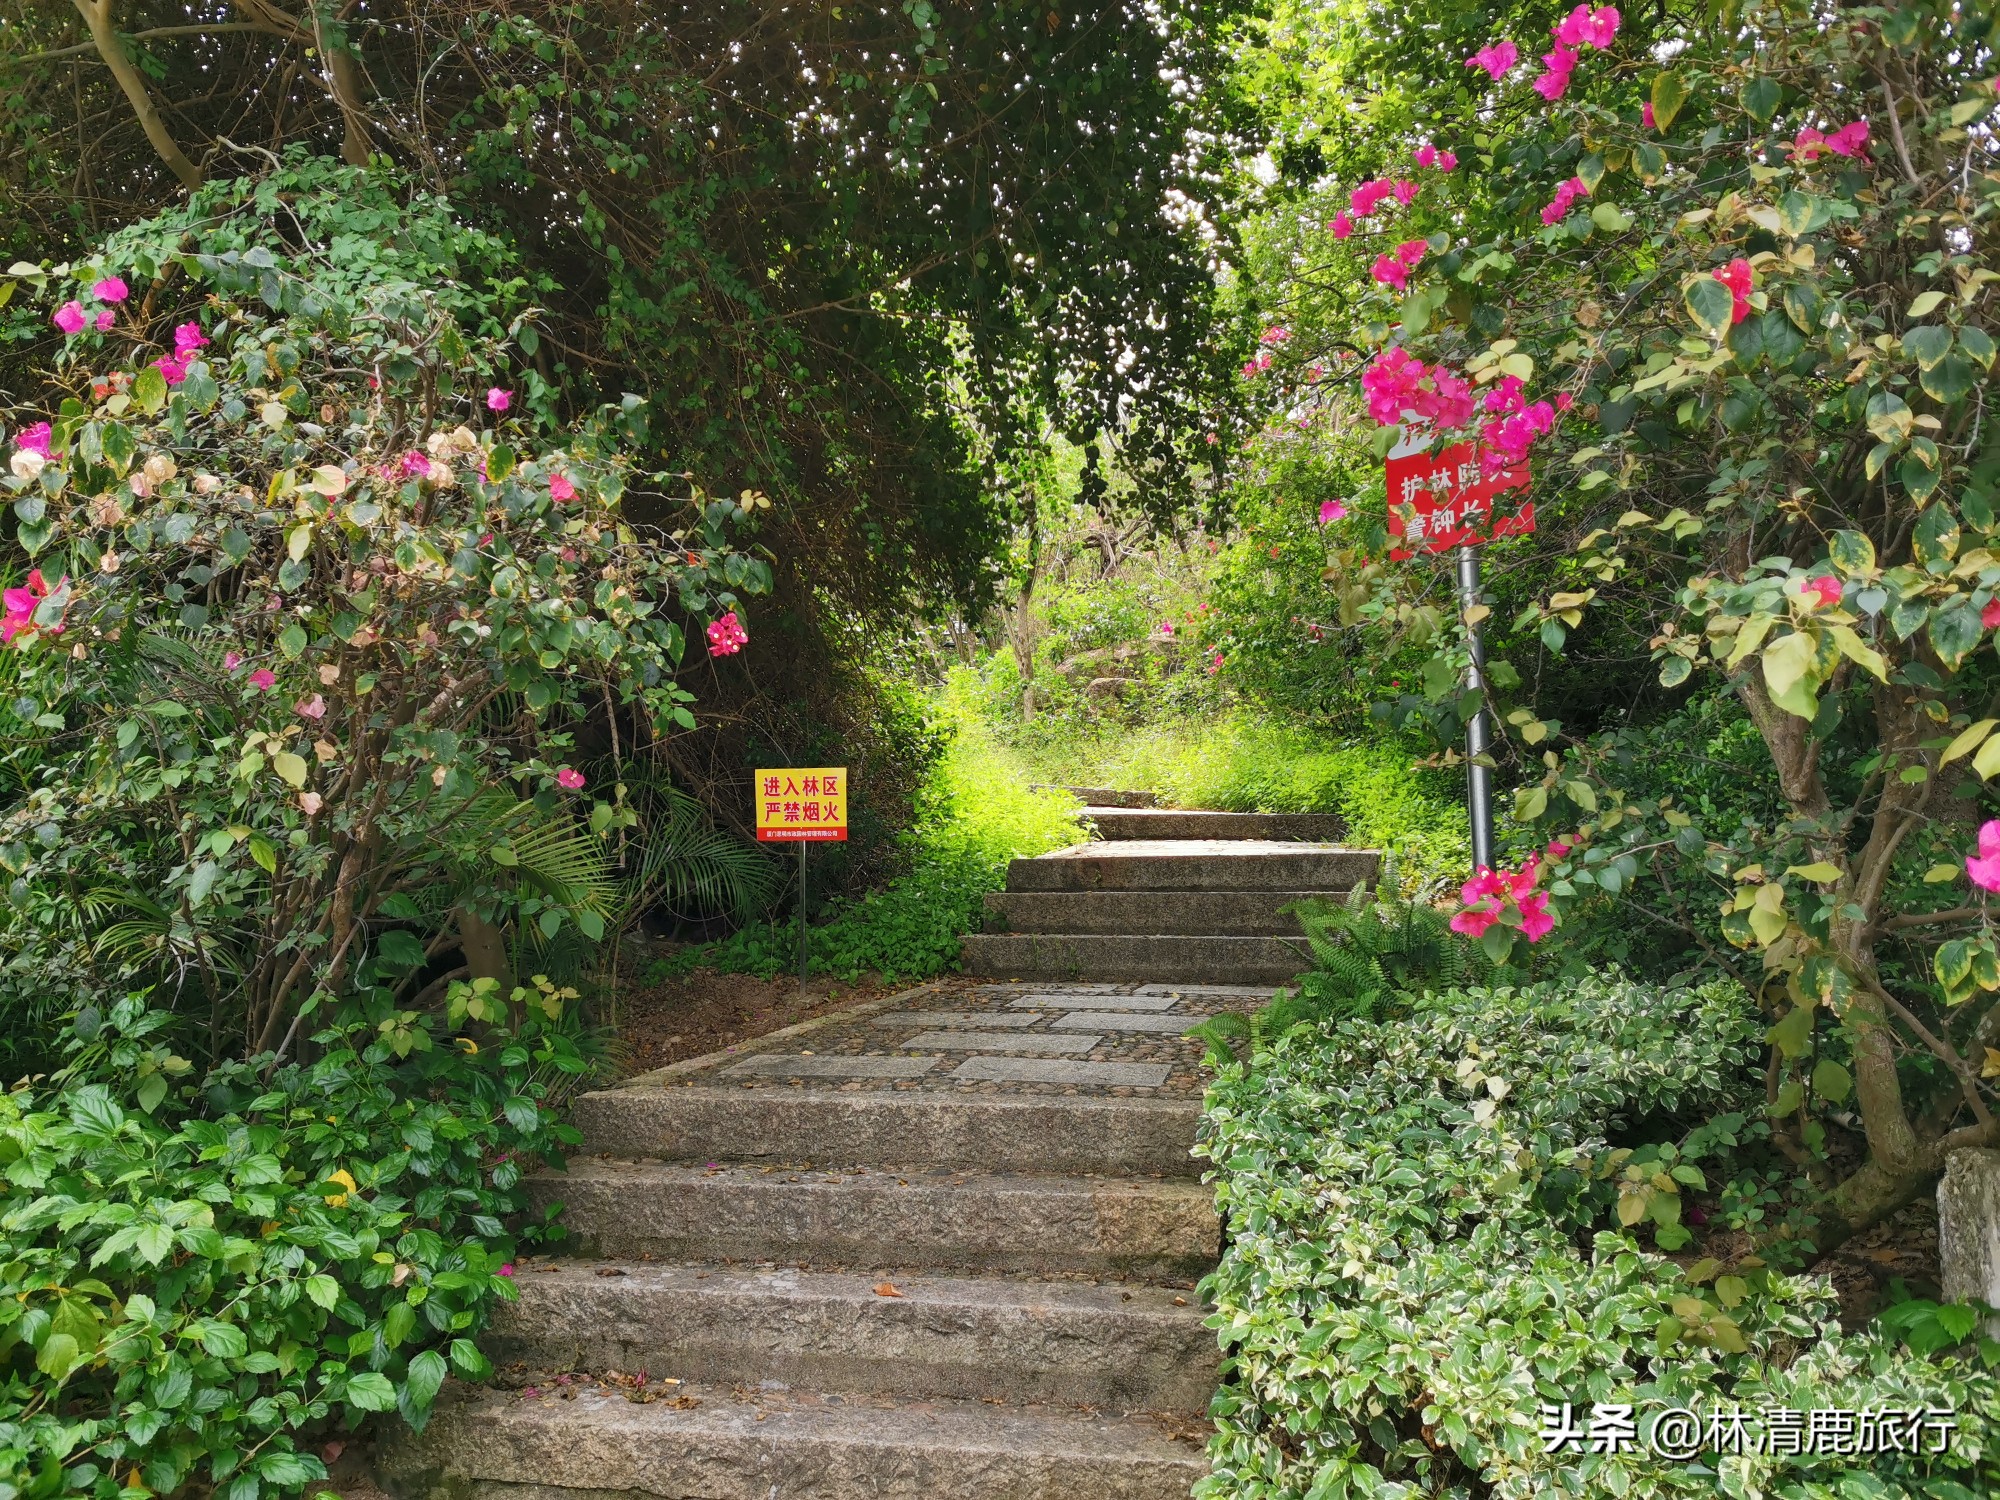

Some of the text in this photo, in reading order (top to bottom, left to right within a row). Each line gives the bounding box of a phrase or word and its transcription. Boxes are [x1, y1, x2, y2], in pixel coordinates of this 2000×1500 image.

[1406, 496, 1508, 541] 警钟长
[763, 776, 838, 797] 进入林区
[764, 801, 840, 822] 严禁烟火
